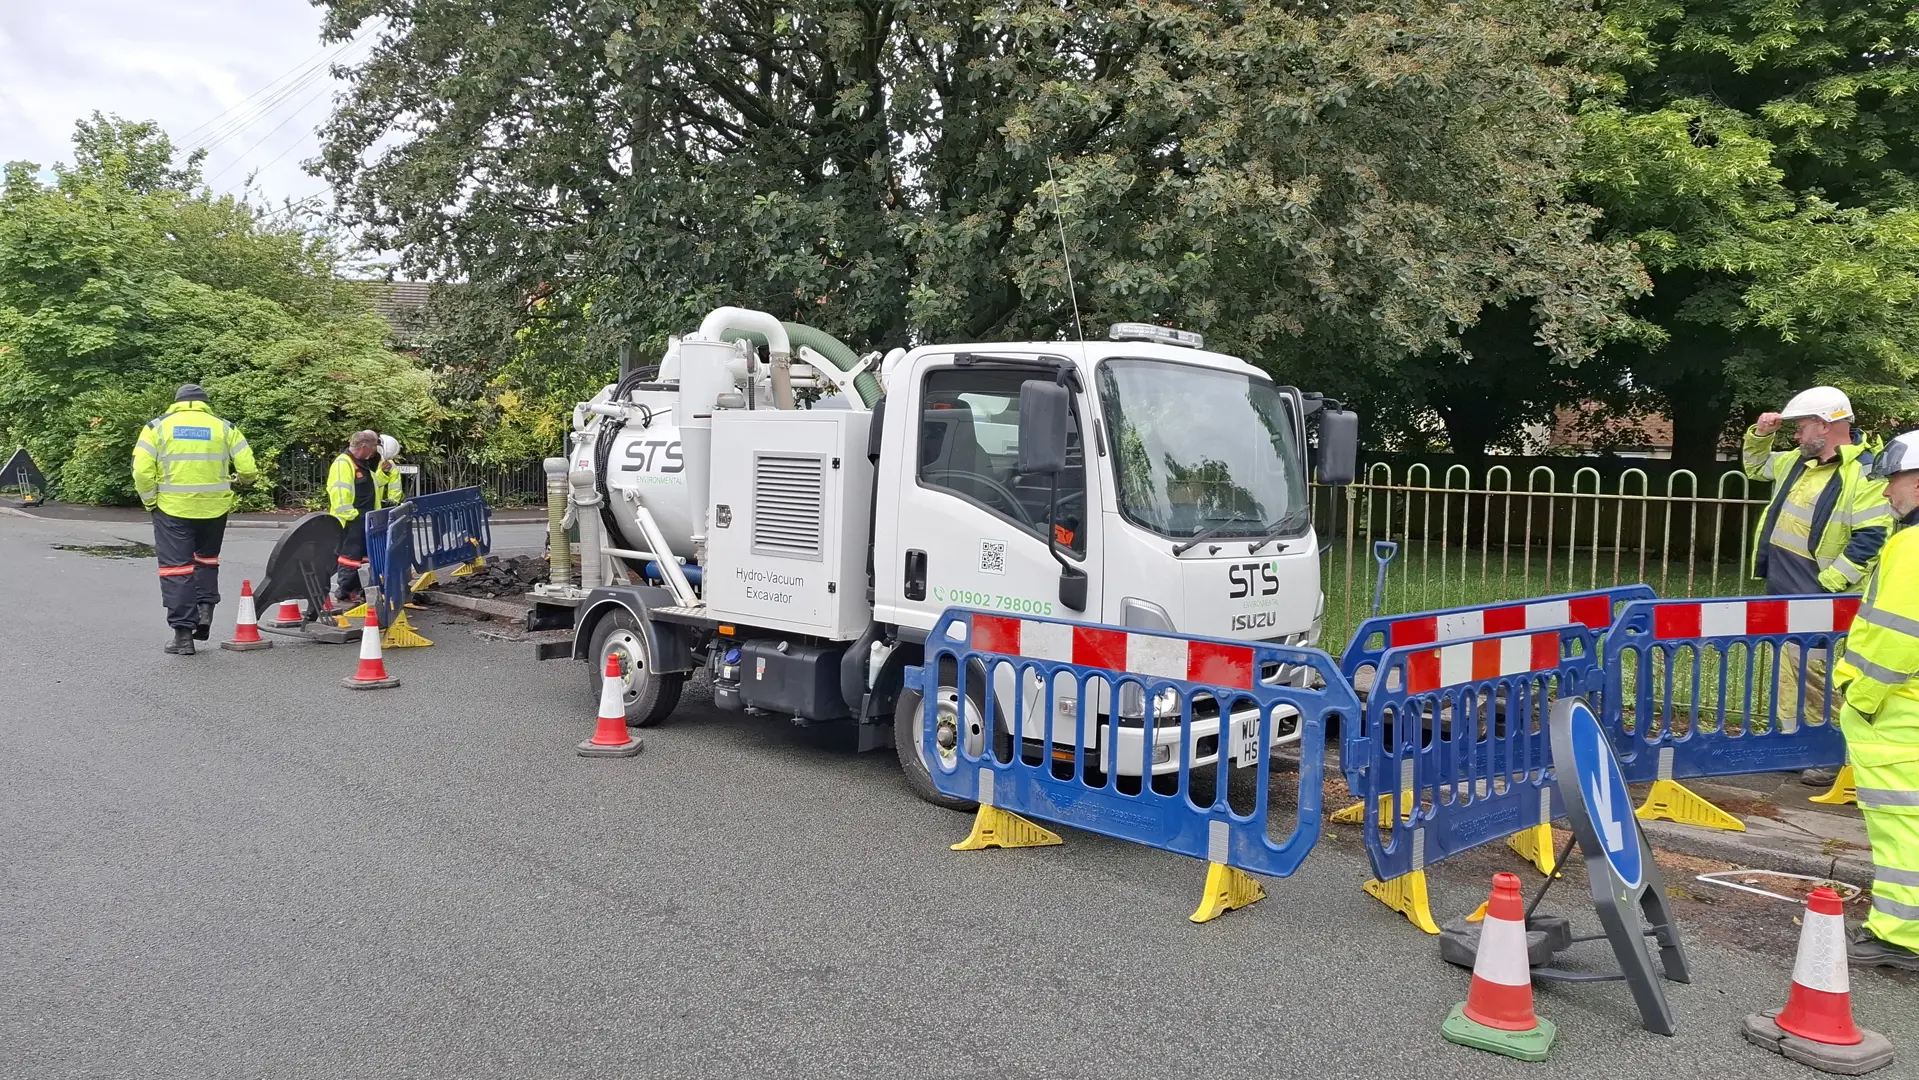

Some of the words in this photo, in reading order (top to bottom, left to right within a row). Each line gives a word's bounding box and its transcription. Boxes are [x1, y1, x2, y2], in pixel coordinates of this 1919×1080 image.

[621, 440, 684, 473] STS
[636, 475, 684, 485] ENVIRONMENTAL
[736, 567, 804, 587] Hydro-Vacuum
[1228, 563, 1279, 598] STS
[746, 586, 793, 604] Excavator
[949, 589, 990, 607] 01902
[995, 595, 1052, 615] 798005
[1231, 611, 1277, 631] ISUZU
[1242, 718, 1260, 740] WU7
[1244, 741, 1258, 762] HS
